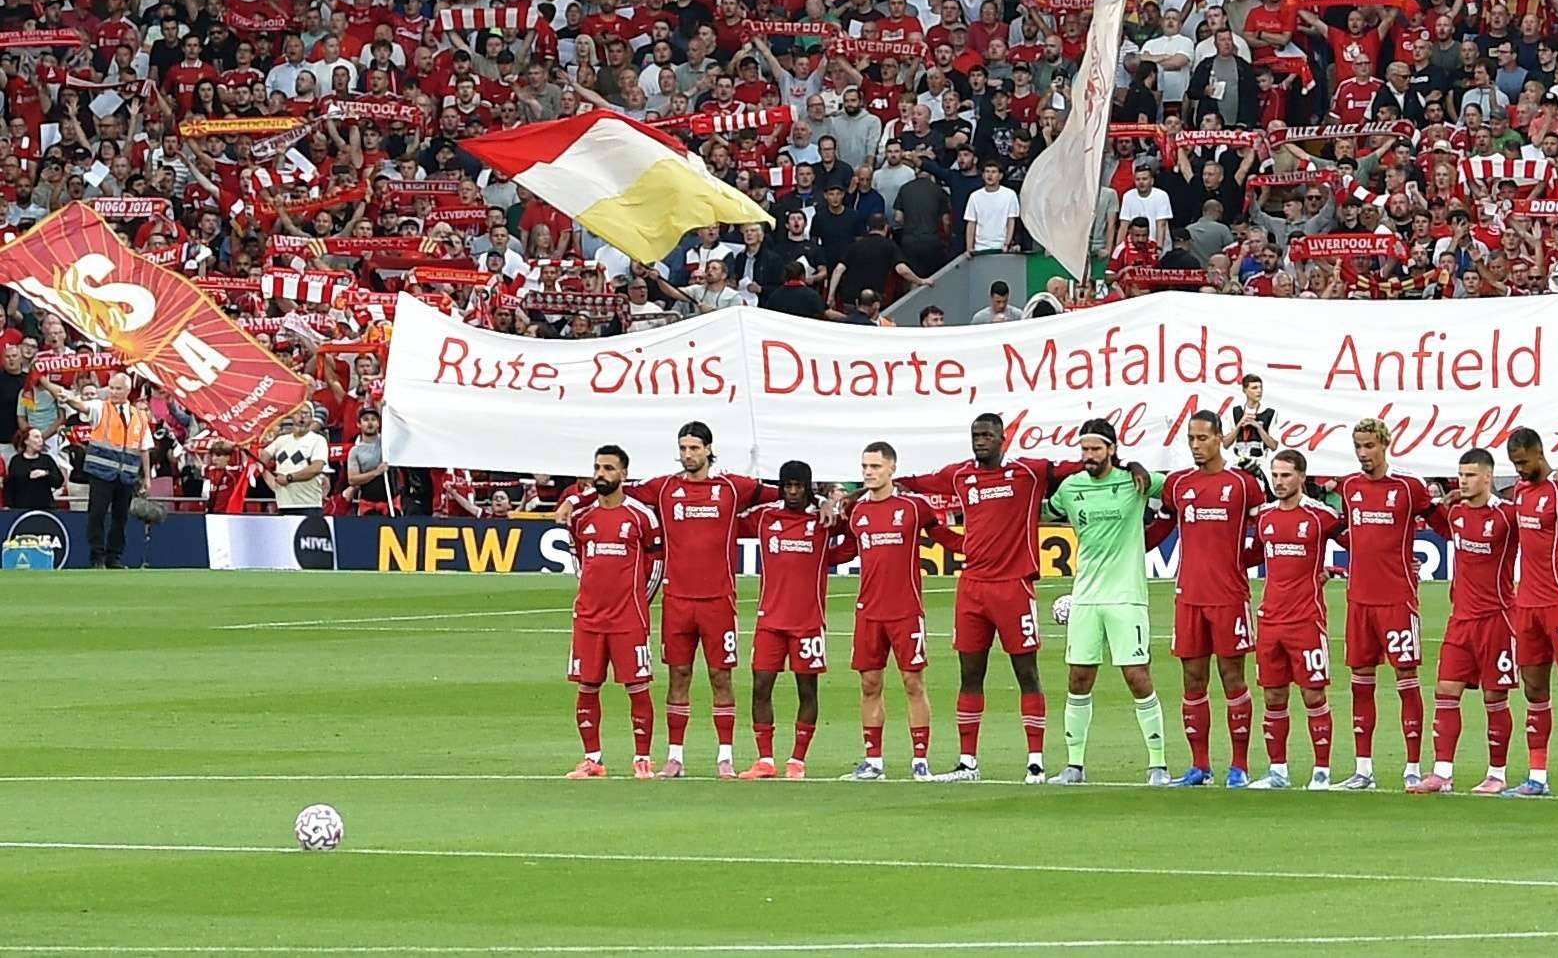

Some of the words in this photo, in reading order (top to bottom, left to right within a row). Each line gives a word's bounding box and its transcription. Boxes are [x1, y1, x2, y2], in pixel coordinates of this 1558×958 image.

[750, 20, 829, 34] LIVERPOOL
[845, 40, 922, 56] LIVERPOOL
[1285, 126, 1317, 140] ALLEZ
[1322, 124, 1356, 136] ALLEZ
[1359, 121, 1394, 134] ALLEZ
[94, 200, 126, 213] DIOGO
[128, 200, 154, 213] JOTA
[439, 208, 487, 221] LIVERPOOL
[1308, 238, 1373, 251] LIVERPOOL
[1375, 237, 1390, 249] FC
[37, 356, 80, 371] DIOGO
[83, 354, 122, 368] JOTA
[433, 337, 565, 400] Rute,
[590, 340, 737, 404] Dinis,
[761, 339, 977, 404] Duarte,
[1002, 324, 1243, 392] Mafalda
[1324, 326, 1542, 391] Anfield
[378, 526, 522, 574] NEW
[1020, 615, 1034, 636] 5
[1135, 624, 1142, 645] 1
[1235, 617, 1247, 638] 4
[723, 630, 736, 653] 8
[798, 637, 824, 659] 30
[910, 632, 923, 654] 7
[1386, 630, 1414, 654] 22
[1303, 648, 1325, 671] 10
[1496, 649, 1512, 673] 6
